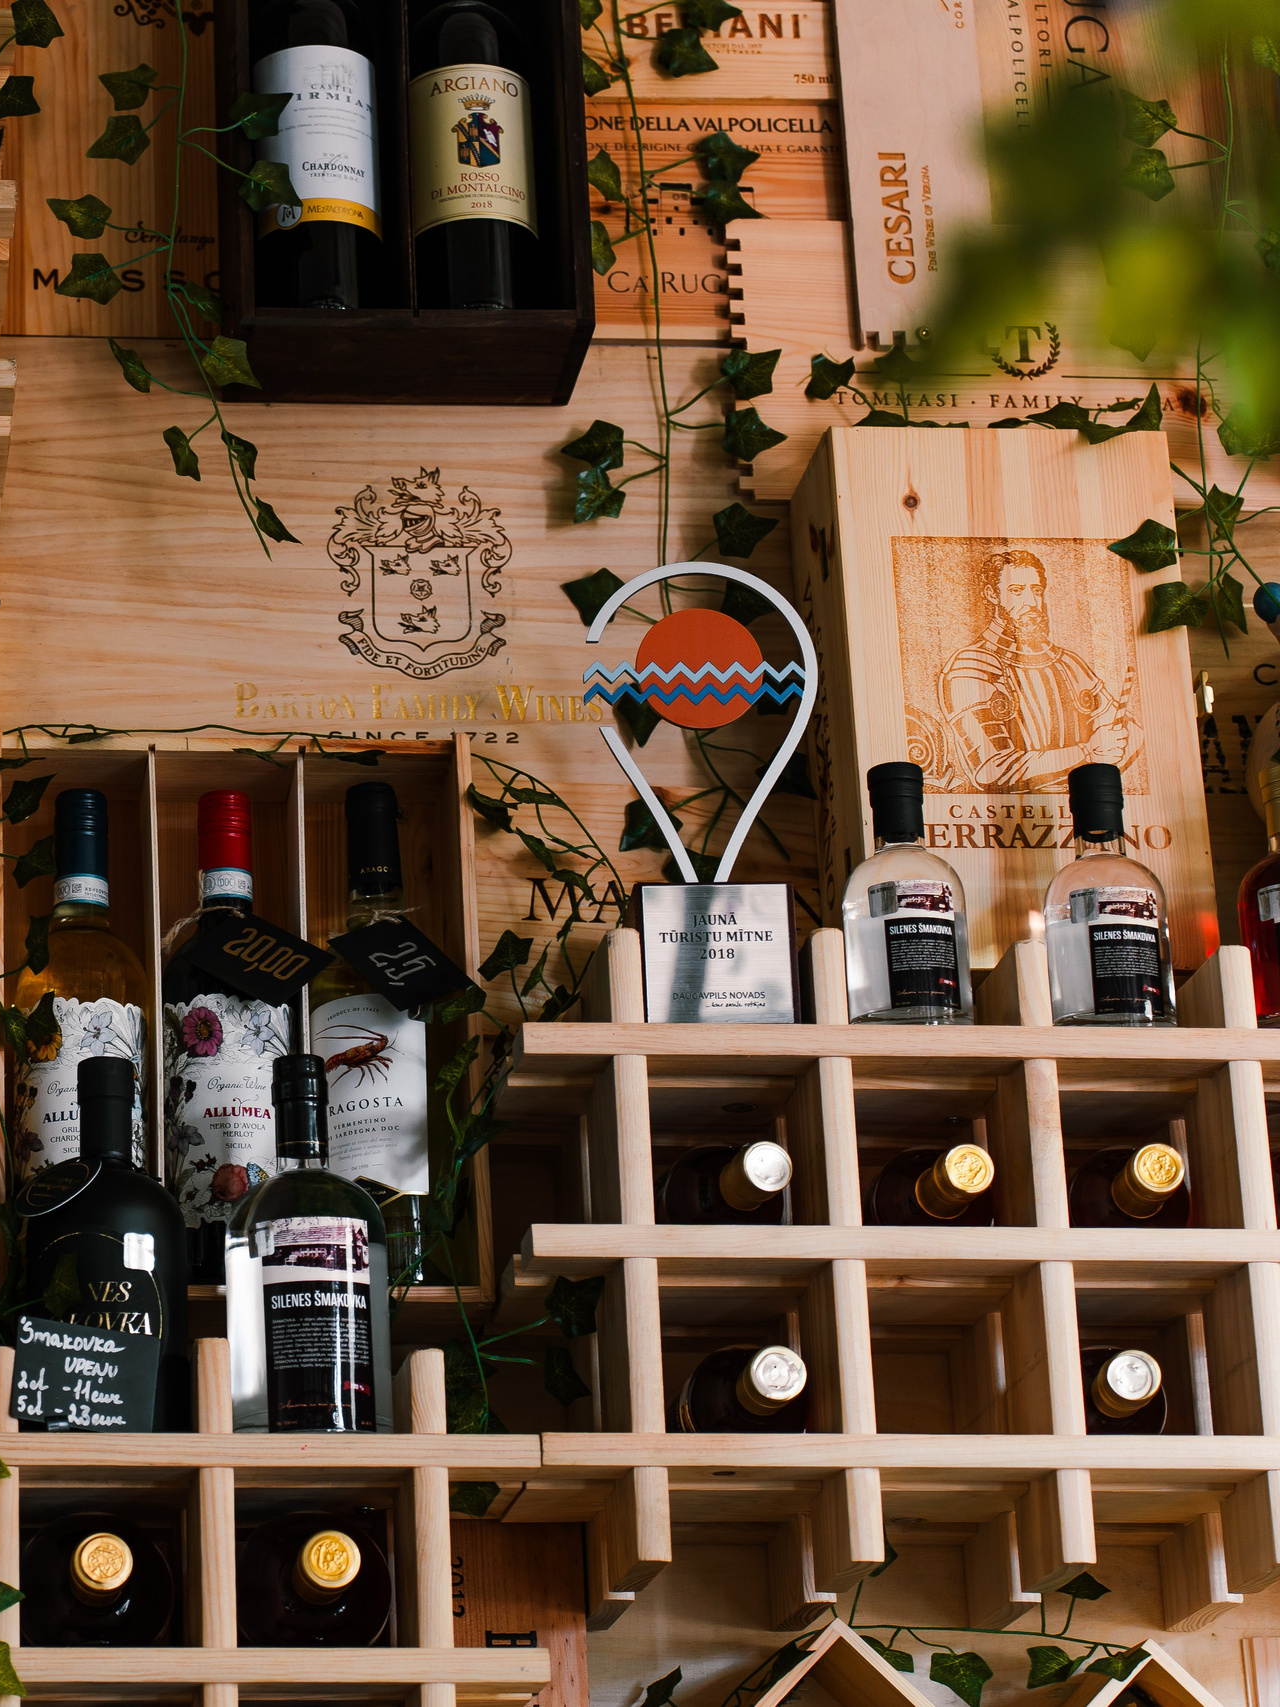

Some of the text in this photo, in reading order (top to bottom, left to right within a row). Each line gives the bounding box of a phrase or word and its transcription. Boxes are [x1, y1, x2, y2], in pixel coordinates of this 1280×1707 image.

[625, 13, 801, 39] BEANI
[793, 73, 815, 84] 750
[430, 76, 519, 98] ARGIANO
[296, 92, 373, 114] IRMIAN
[630, 116, 691, 132] DELLA
[694, 117, 833, 134] VALPOLICELLA
[302, 161, 366, 178] CHARDONNAY
[460, 172, 500, 182] ROSSO
[431, 190, 443, 200] DI
[447, 183, 526, 201] MONTALCINO
[470, 201, 493, 209] 2018
[878, 152, 916, 284] CESARI
[836, 391, 958, 408] TOMMASI
[357, 636, 487, 677] FIDE ET FORTITUDINE
[234, 681, 604, 723] BARTON FAMILY WINES
[948, 804, 1072, 820] CASTELL
[926, 823, 1171, 850] ERRAZZNO
[692, 911, 737, 927] JAUNĀ
[659, 927, 773, 944] TŪRISTU MĪTNE
[889, 925, 917, 936] SILENES
[1093, 930, 1122, 941] SILENES
[223, 927, 310, 981] 20,00
[699, 949, 735, 960] 2018
[672, 991, 766, 1000] DAUGAVPILS NOVADS
[327, 1009, 352, 1022] PRODUCT
[207, 1076, 267, 1092] Organic Wine
[202, 1106, 271, 1120] ALLUMEA
[209, 1122, 266, 1131] NERO D'AVOLA
[333, 1117, 387, 1131] VERMENTINO
[222, 1130, 254, 1138] MERLOT
[335, 1127, 377, 1140] SARDEGNA
[225, 1142, 252, 1150] SICILIA
[271, 1290, 367, 1310] SILENES ŠMAKOVKA
